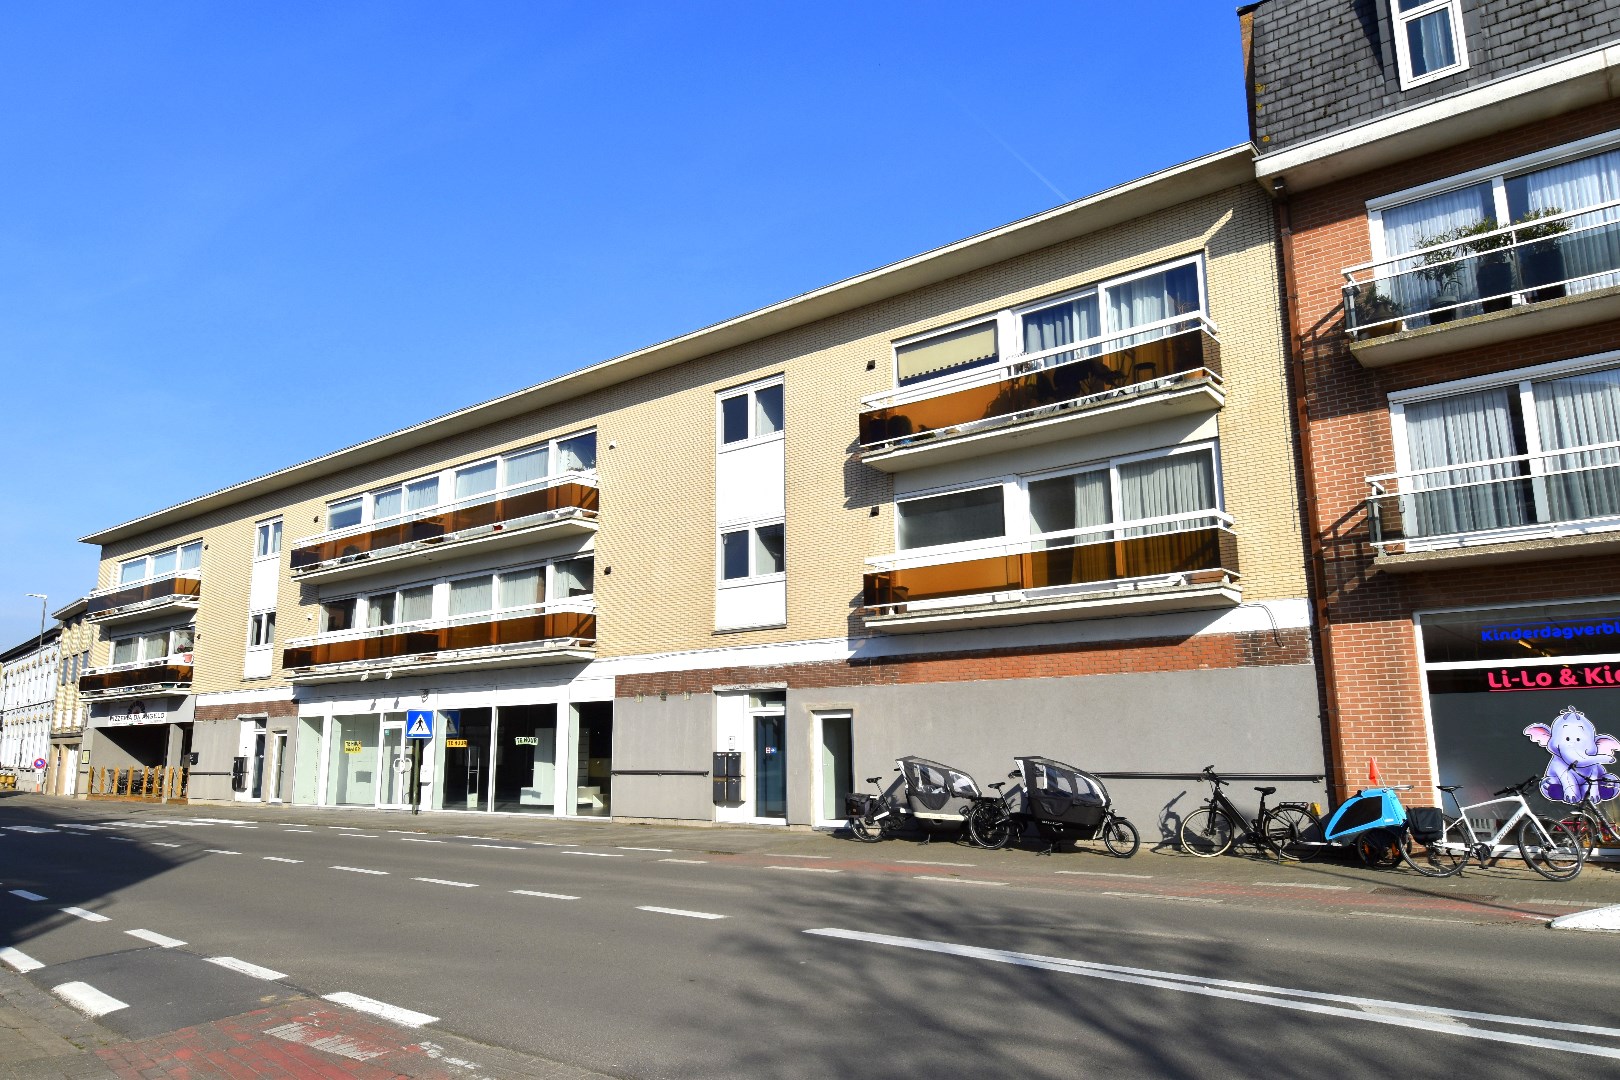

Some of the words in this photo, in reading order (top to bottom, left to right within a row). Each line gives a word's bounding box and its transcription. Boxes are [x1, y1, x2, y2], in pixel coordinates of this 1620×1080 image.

[1481, 622, 1620, 641] Kinderdagverbl
[1487, 669, 1552, 688] Li-Lo
[1559, 668, 1579, 686] &
